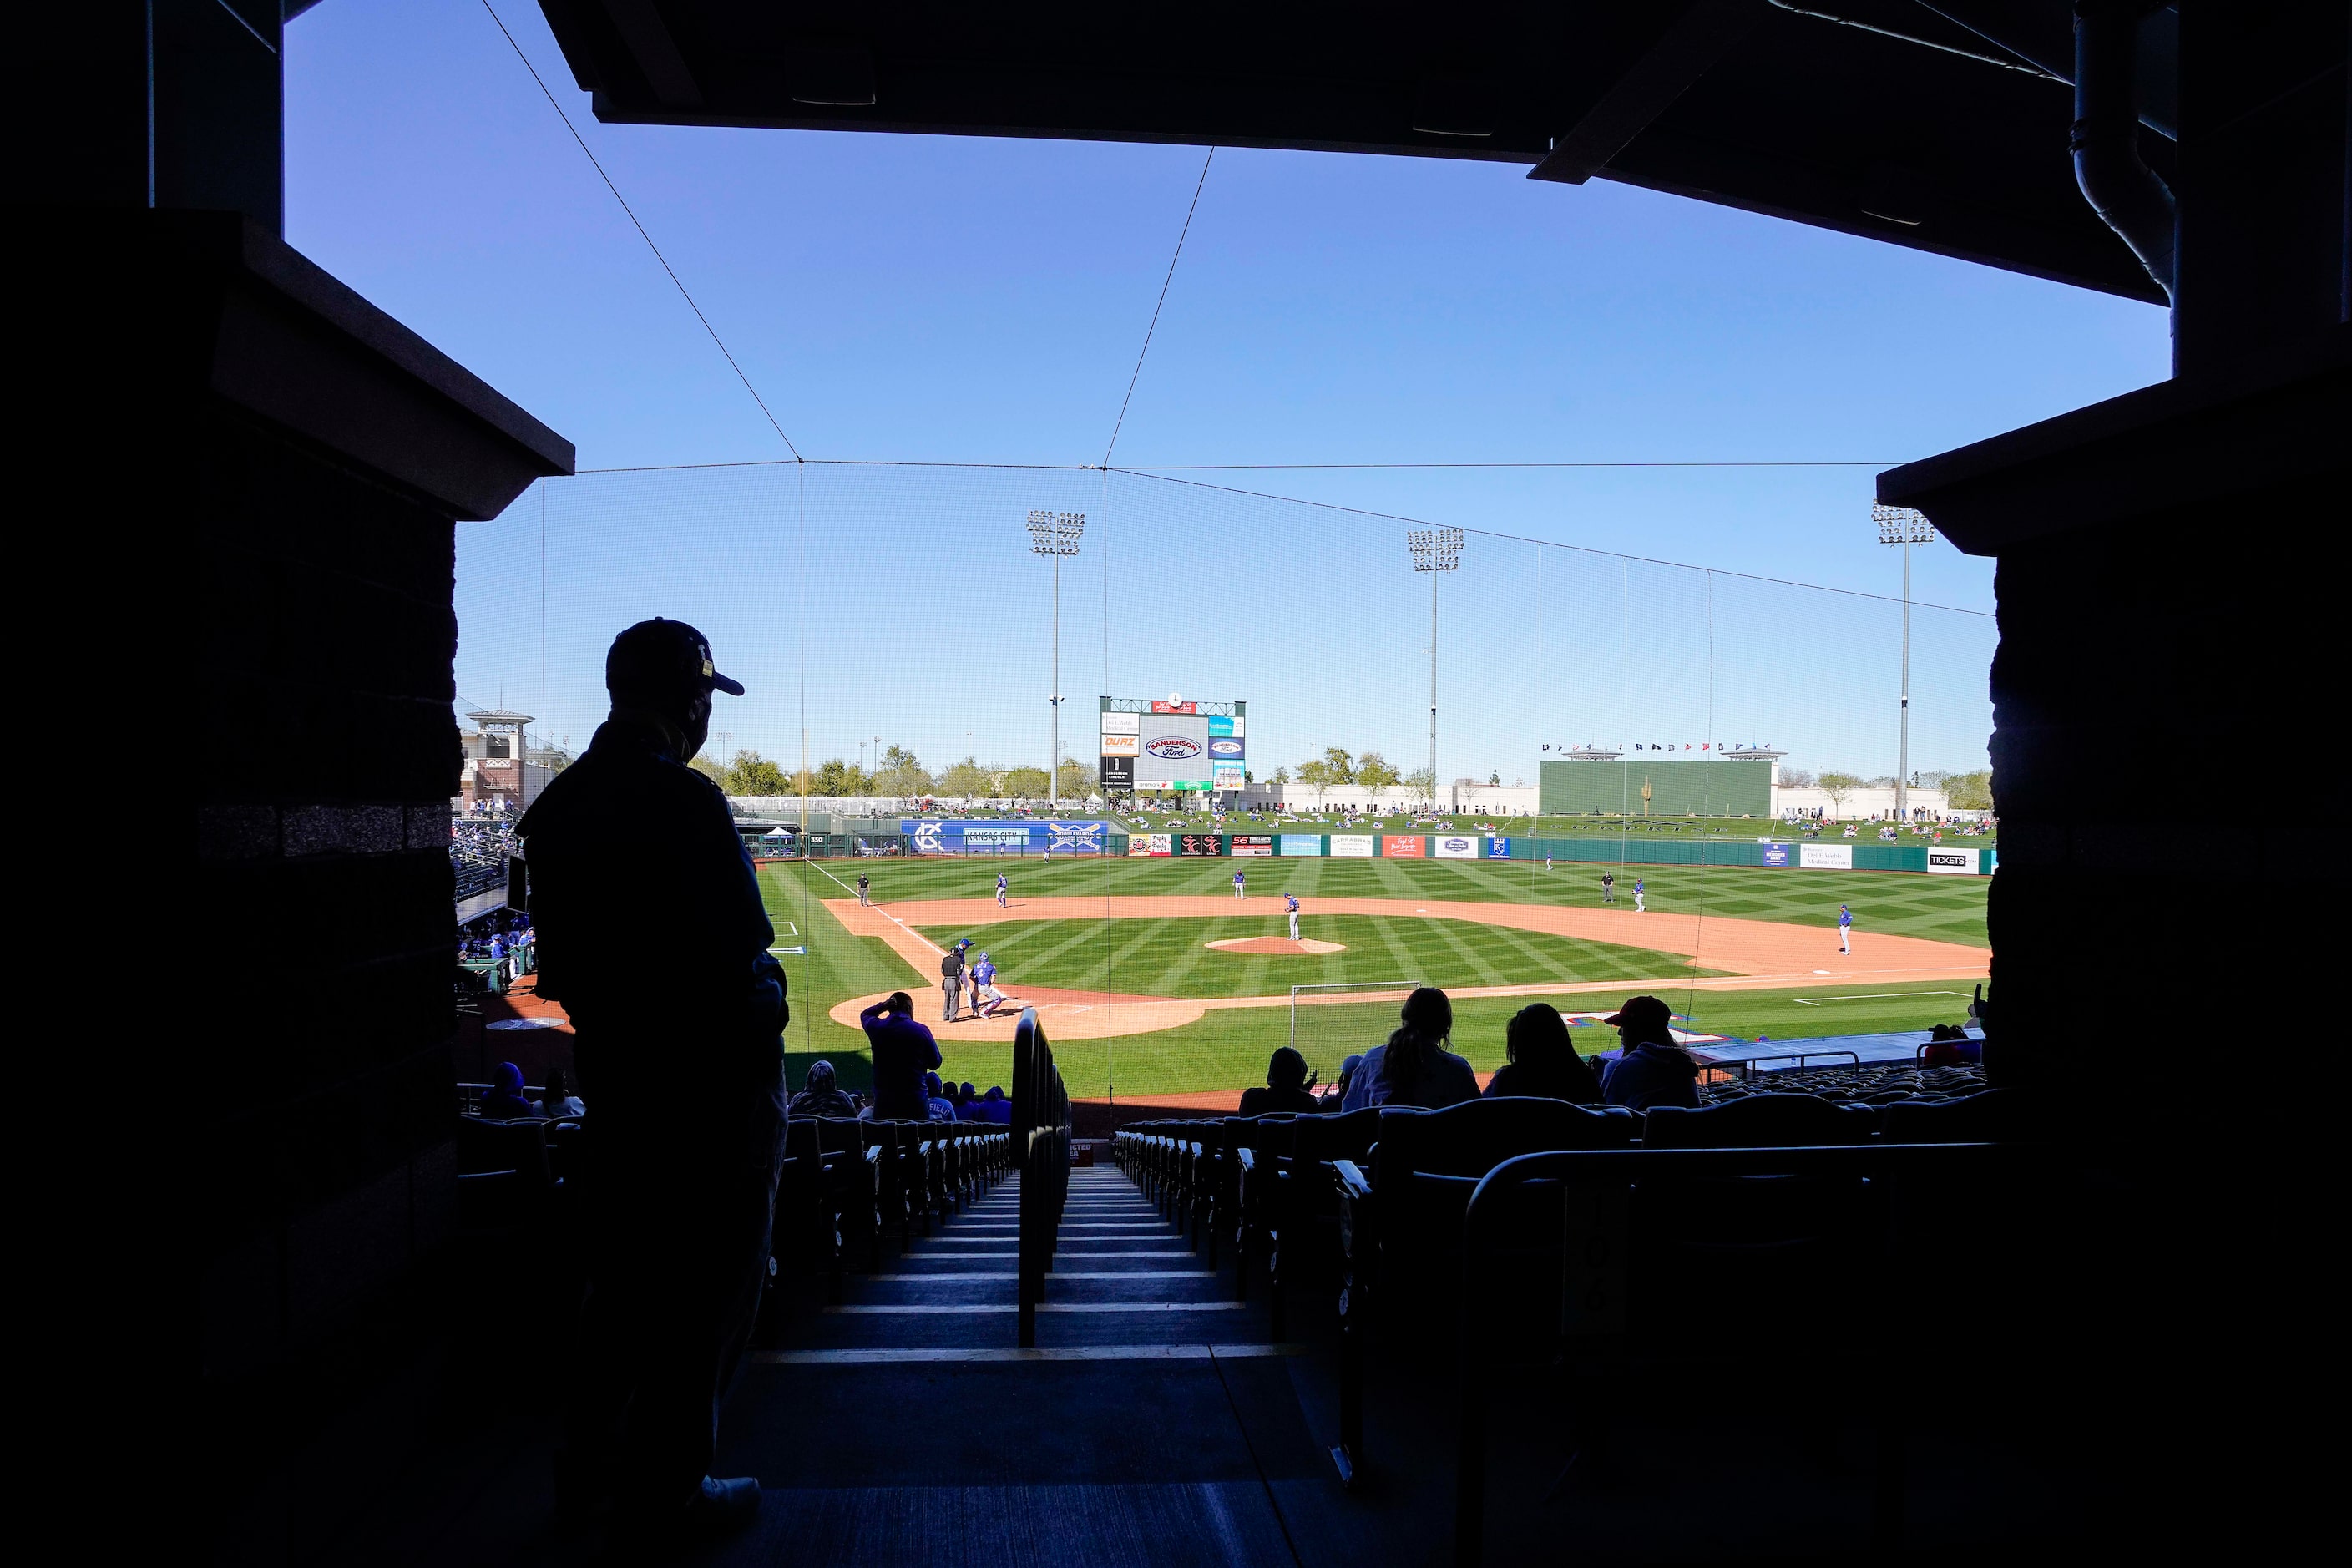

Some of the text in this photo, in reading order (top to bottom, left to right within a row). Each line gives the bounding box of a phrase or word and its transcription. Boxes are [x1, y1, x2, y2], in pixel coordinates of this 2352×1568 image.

[1151, 740, 1198, 751] SANDERSON
[1213, 742, 1241, 750] SANDERSON
[1163, 746, 1185, 756] Ford
[967, 832, 1017, 841] KANSAS CITY
[1585, 1193, 1610, 1310] 106
